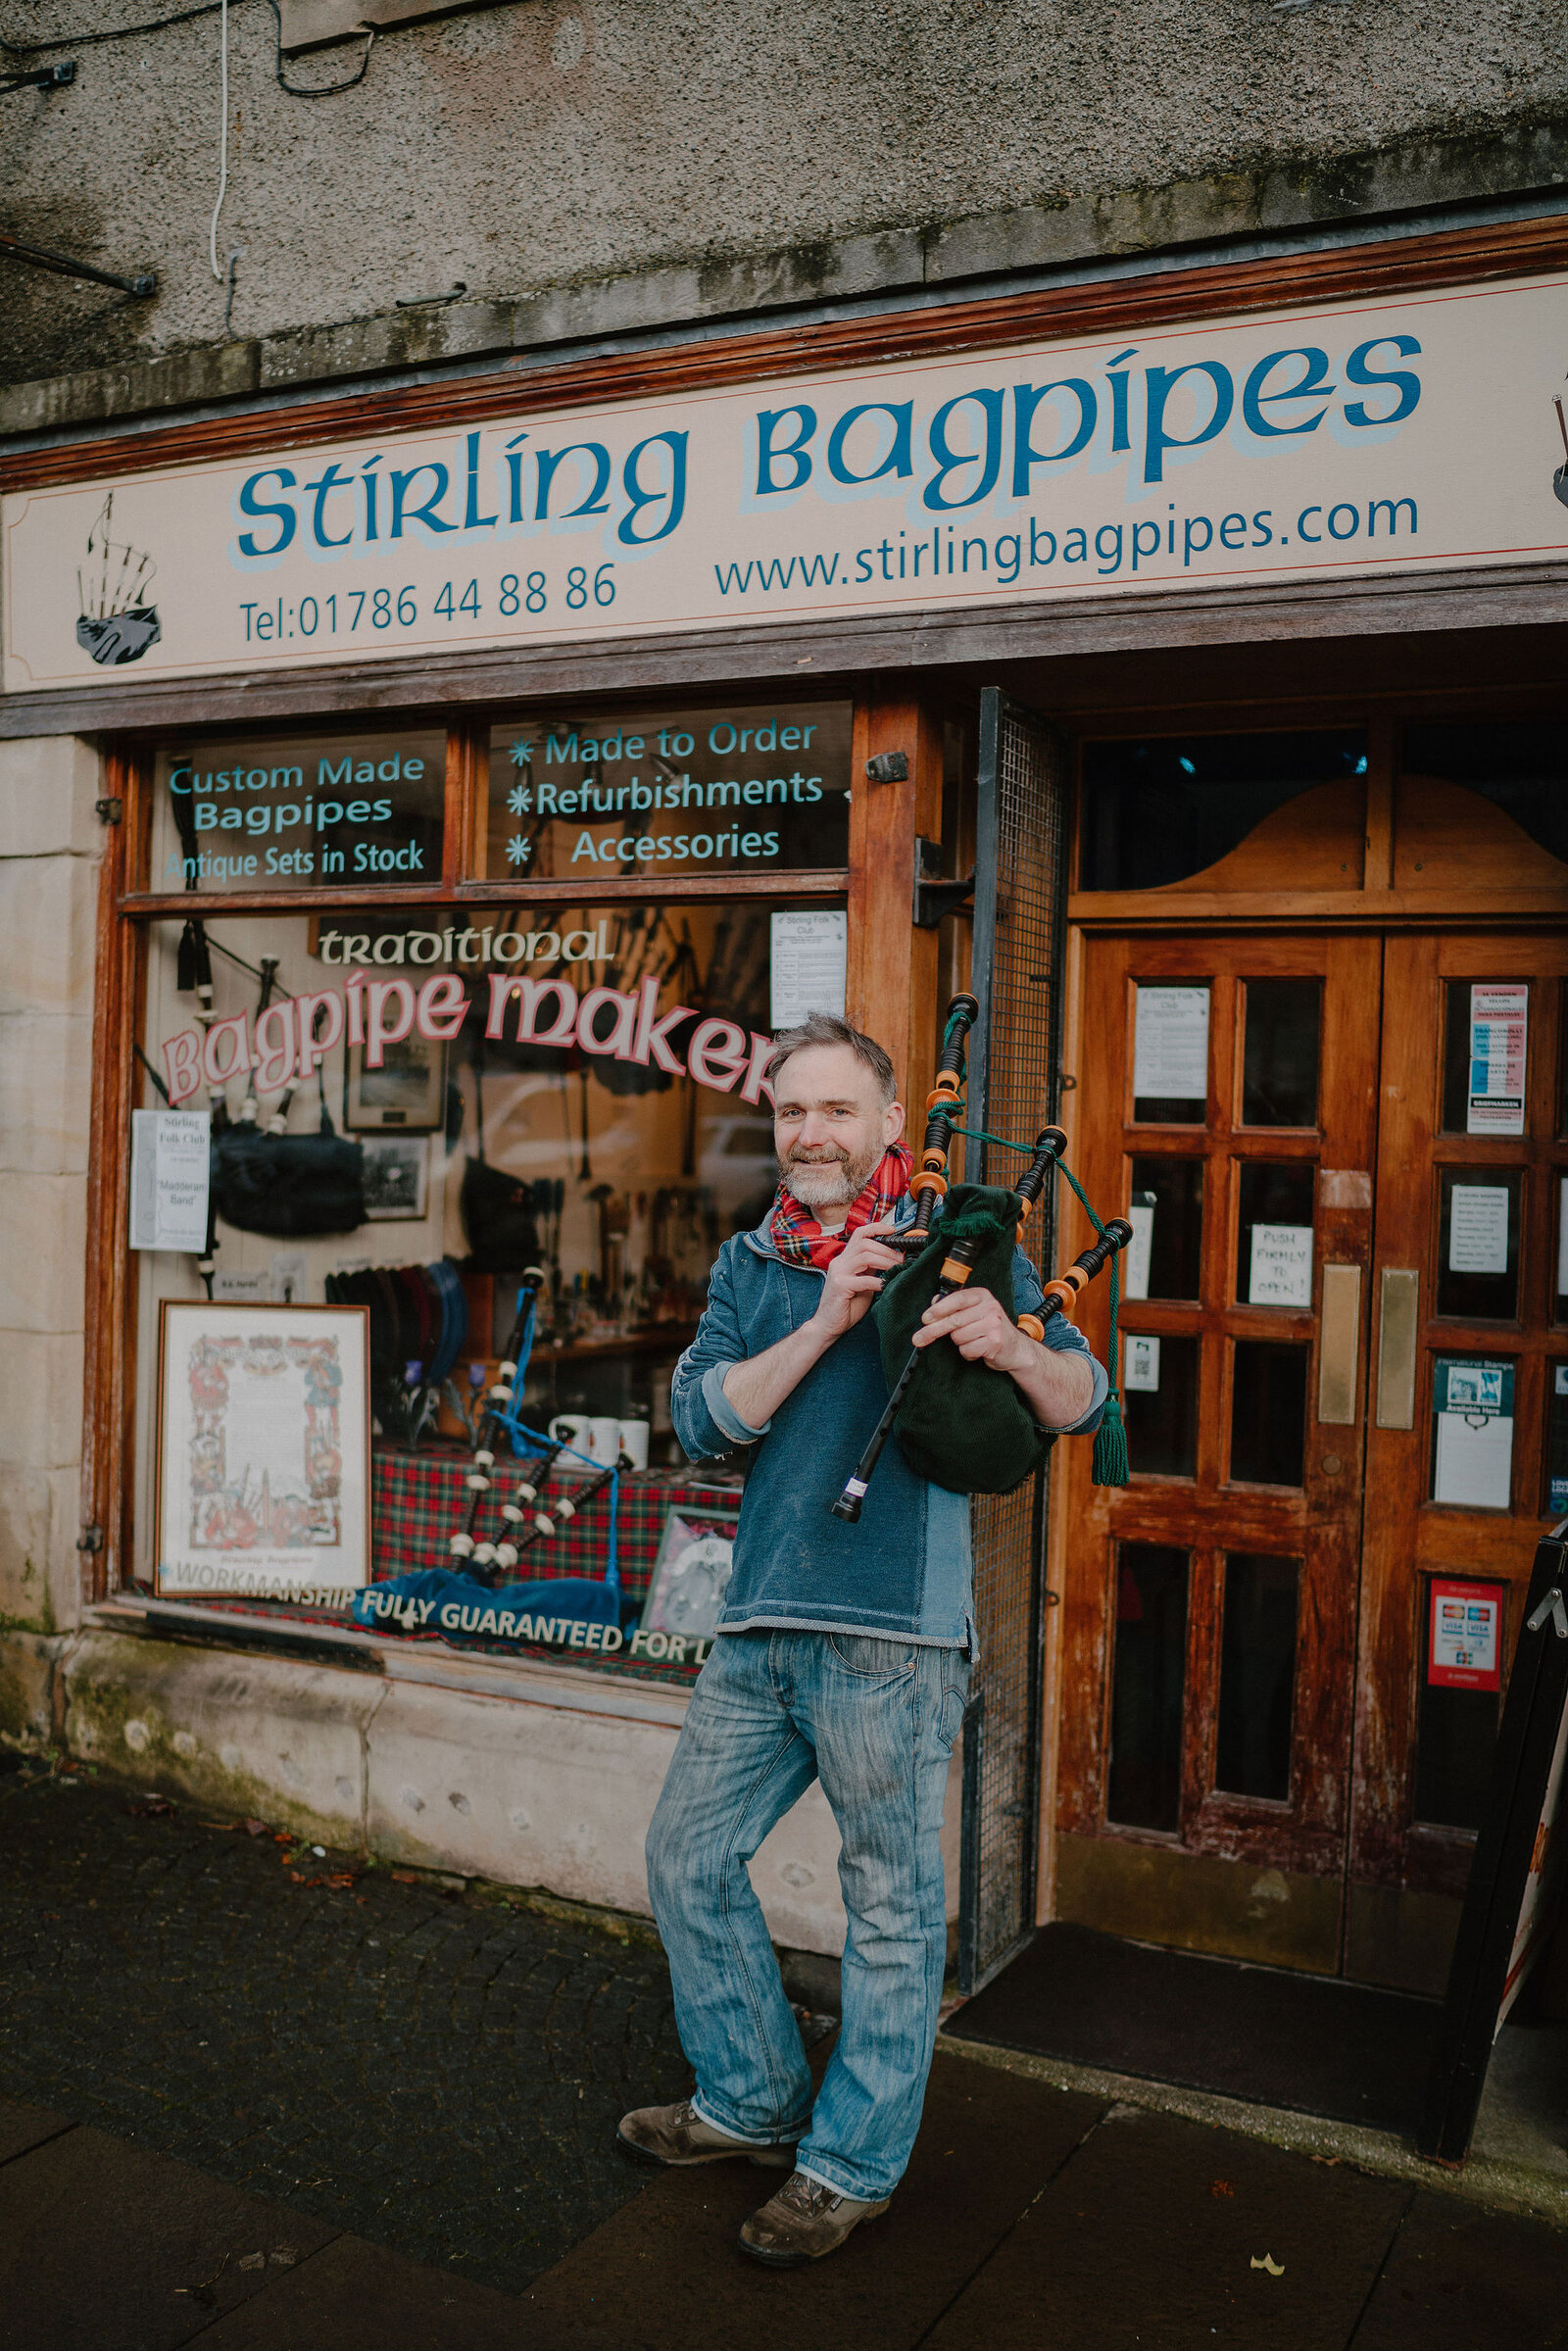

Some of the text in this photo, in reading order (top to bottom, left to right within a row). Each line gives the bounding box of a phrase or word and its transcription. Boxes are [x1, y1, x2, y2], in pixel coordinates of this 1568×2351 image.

[237, 334, 1423, 557] Stirling Bagpipes
[714, 496, 1419, 595] www.stirlingbagpipes.com
[240, 563, 617, 642] Tel:01786 44 88 86
[546, 718, 817, 764] Made to Order
[170, 753, 424, 795] Custom Made
[536, 772, 822, 814] Refurbishments
[194, 796, 393, 835] Bagpipes
[166, 840, 423, 883] Antique Sets in Stock
[571, 824, 780, 863] Accessories
[163, 970, 470, 1105] Bagpipe
[160, 1134, 206, 1145] Folk Club
[1256, 1249, 1306, 1263] FIRMLY
[1263, 1230, 1296, 1245] PUSH
[1484, 1360, 1514, 1370] Stamps
[1446, 1404, 1500, 1415] Available Here
[176, 1560, 357, 1610] WORKMANSHIP
[361, 1591, 436, 1624] FULLY
[441, 1603, 623, 1652] GUARANTEED
[630, 1629, 686, 1662] FOR
